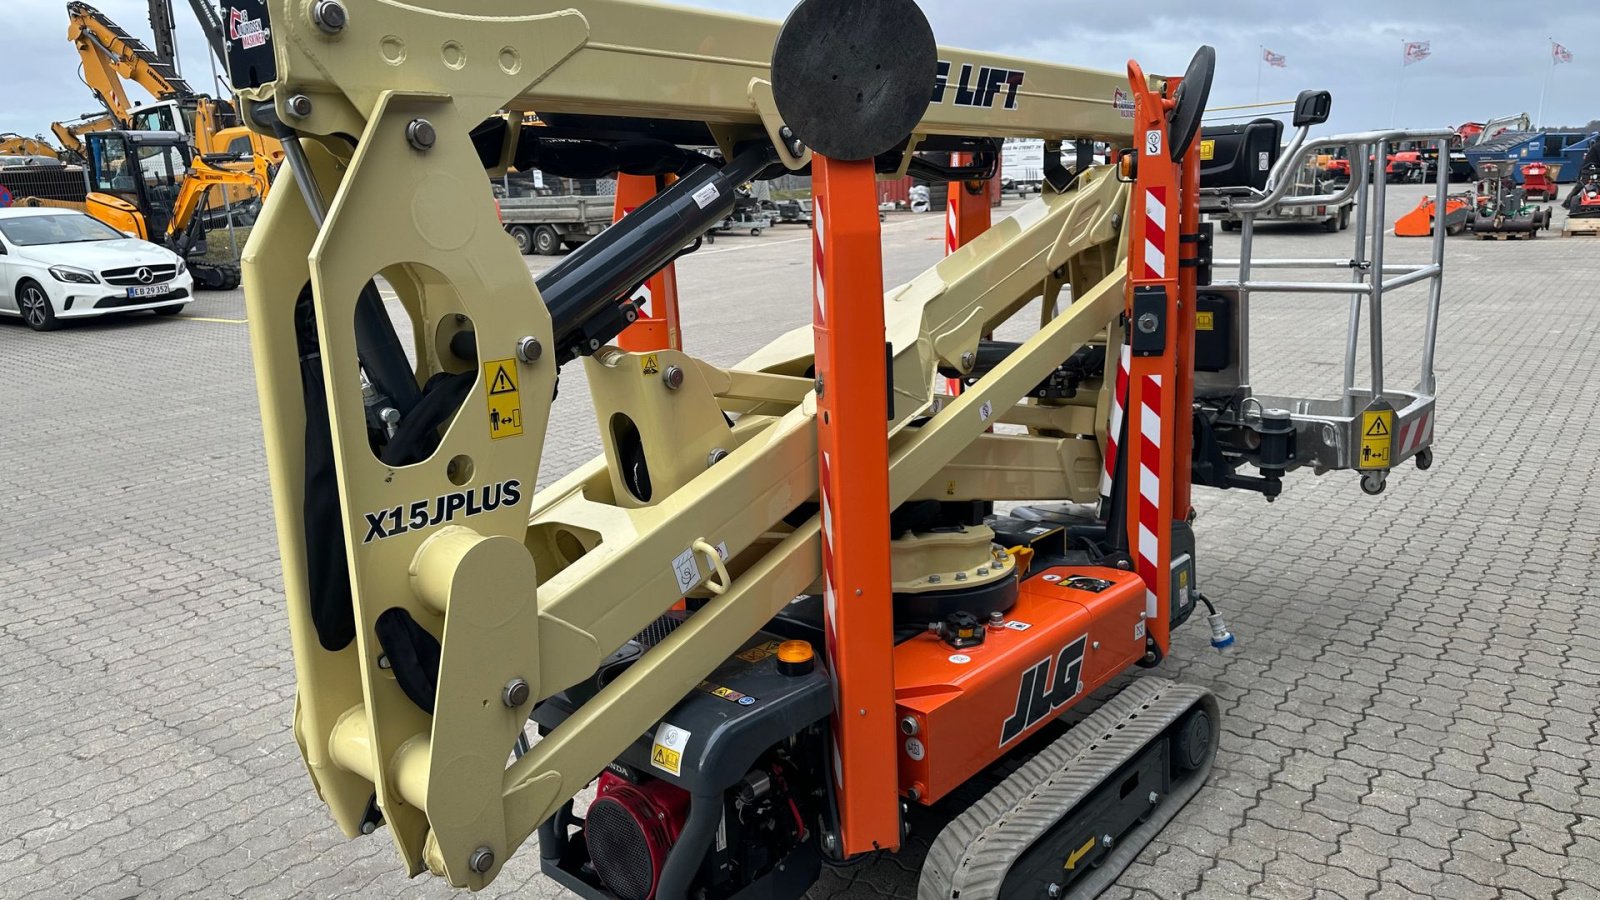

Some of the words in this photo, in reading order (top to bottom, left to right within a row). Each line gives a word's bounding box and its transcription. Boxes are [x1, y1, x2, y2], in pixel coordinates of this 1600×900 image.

[953, 63, 1025, 110] LIFT
[134, 288, 145, 296] EB
[146, 287, 155, 295] 29
[156, 285, 168, 294] 352
[361, 479, 522, 545] X15JPLUS
[999, 632, 1088, 749] JLG
